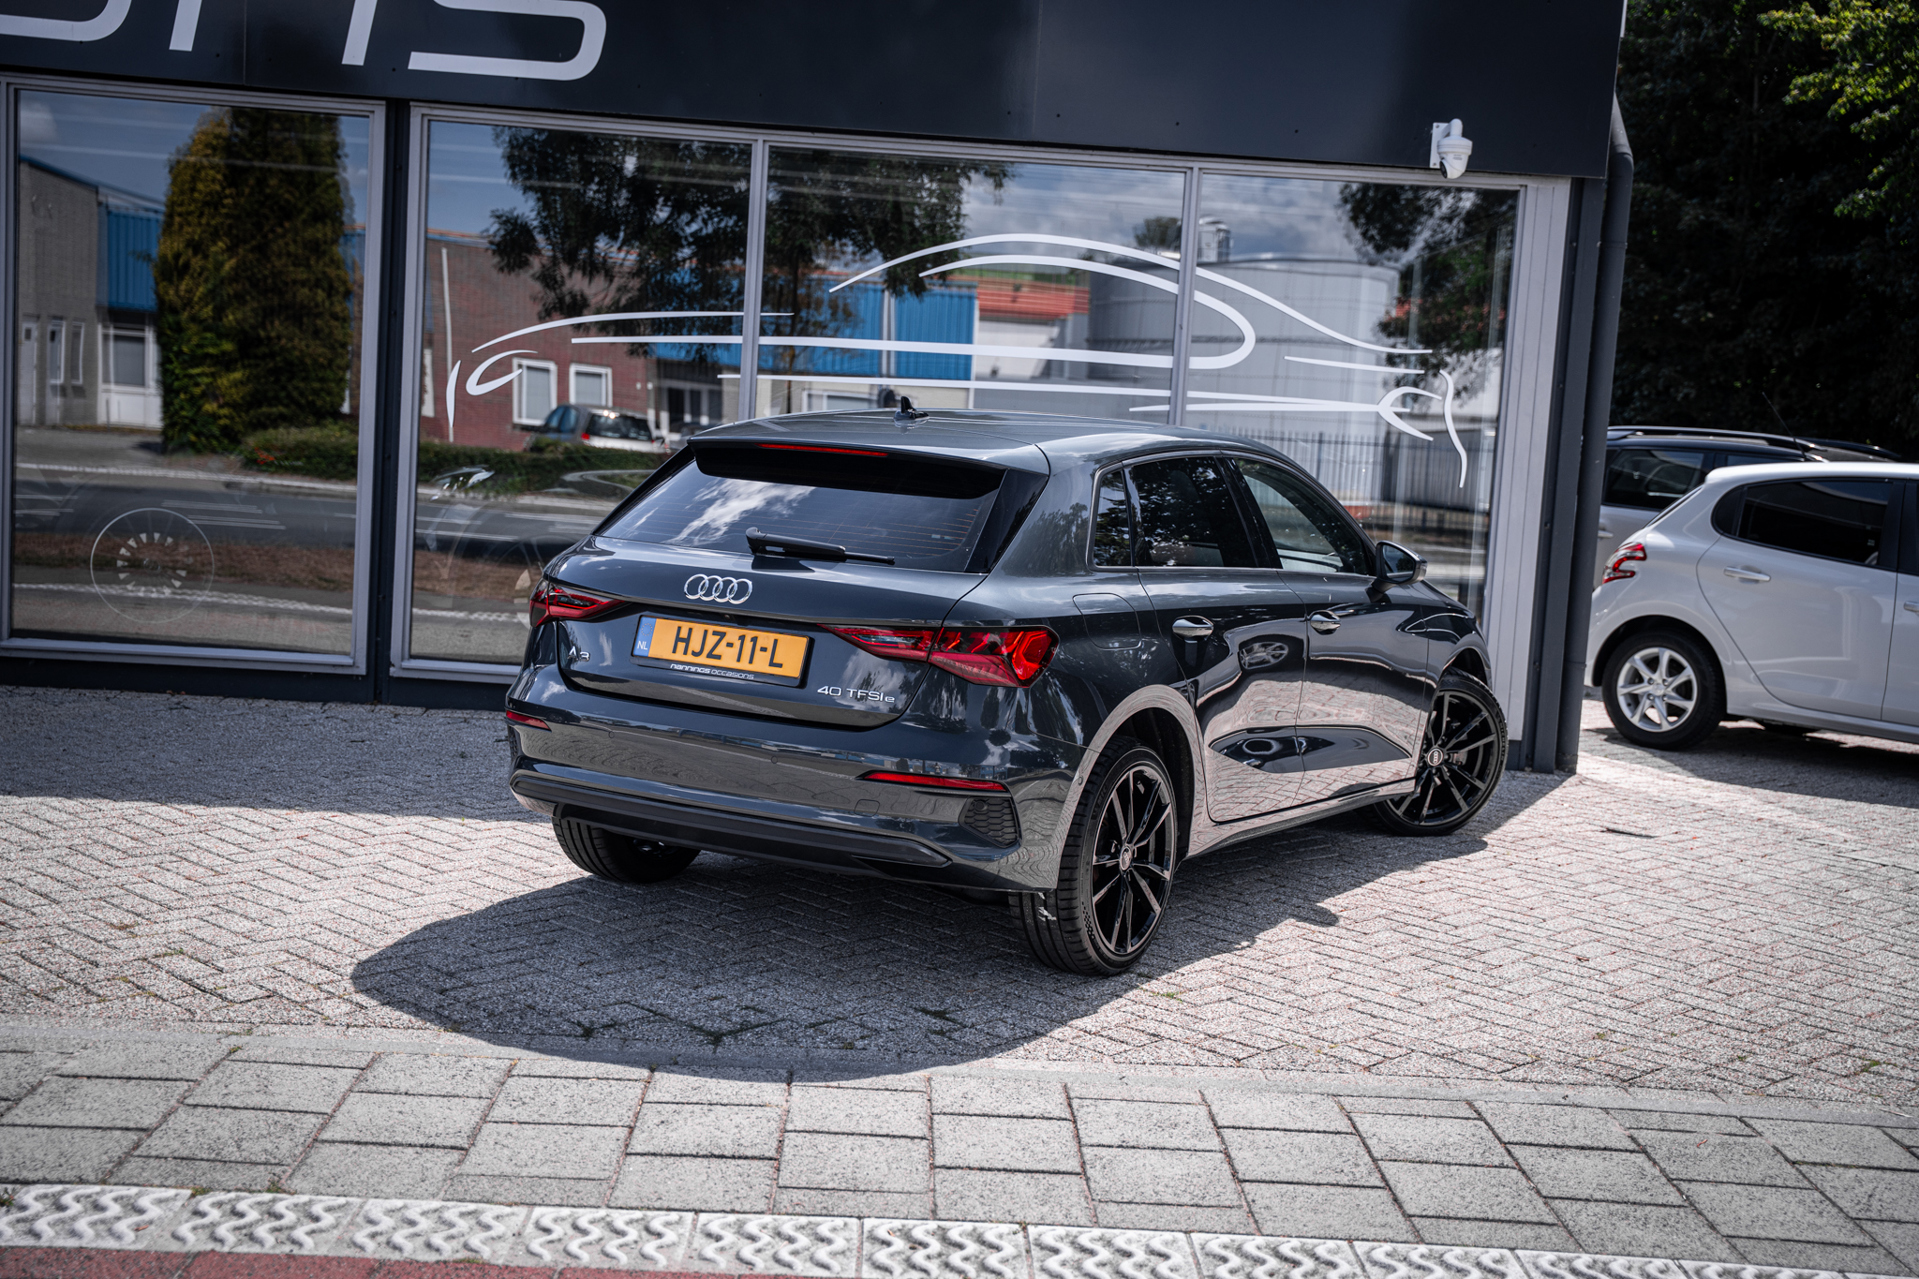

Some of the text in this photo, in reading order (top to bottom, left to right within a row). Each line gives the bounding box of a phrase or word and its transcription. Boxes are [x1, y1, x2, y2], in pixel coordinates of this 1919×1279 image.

[637, 640, 648, 651] NL
[672, 626, 783, 668] HJZ-11-L
[567, 645, 590, 661] A3
[817, 685, 842, 697] 40
